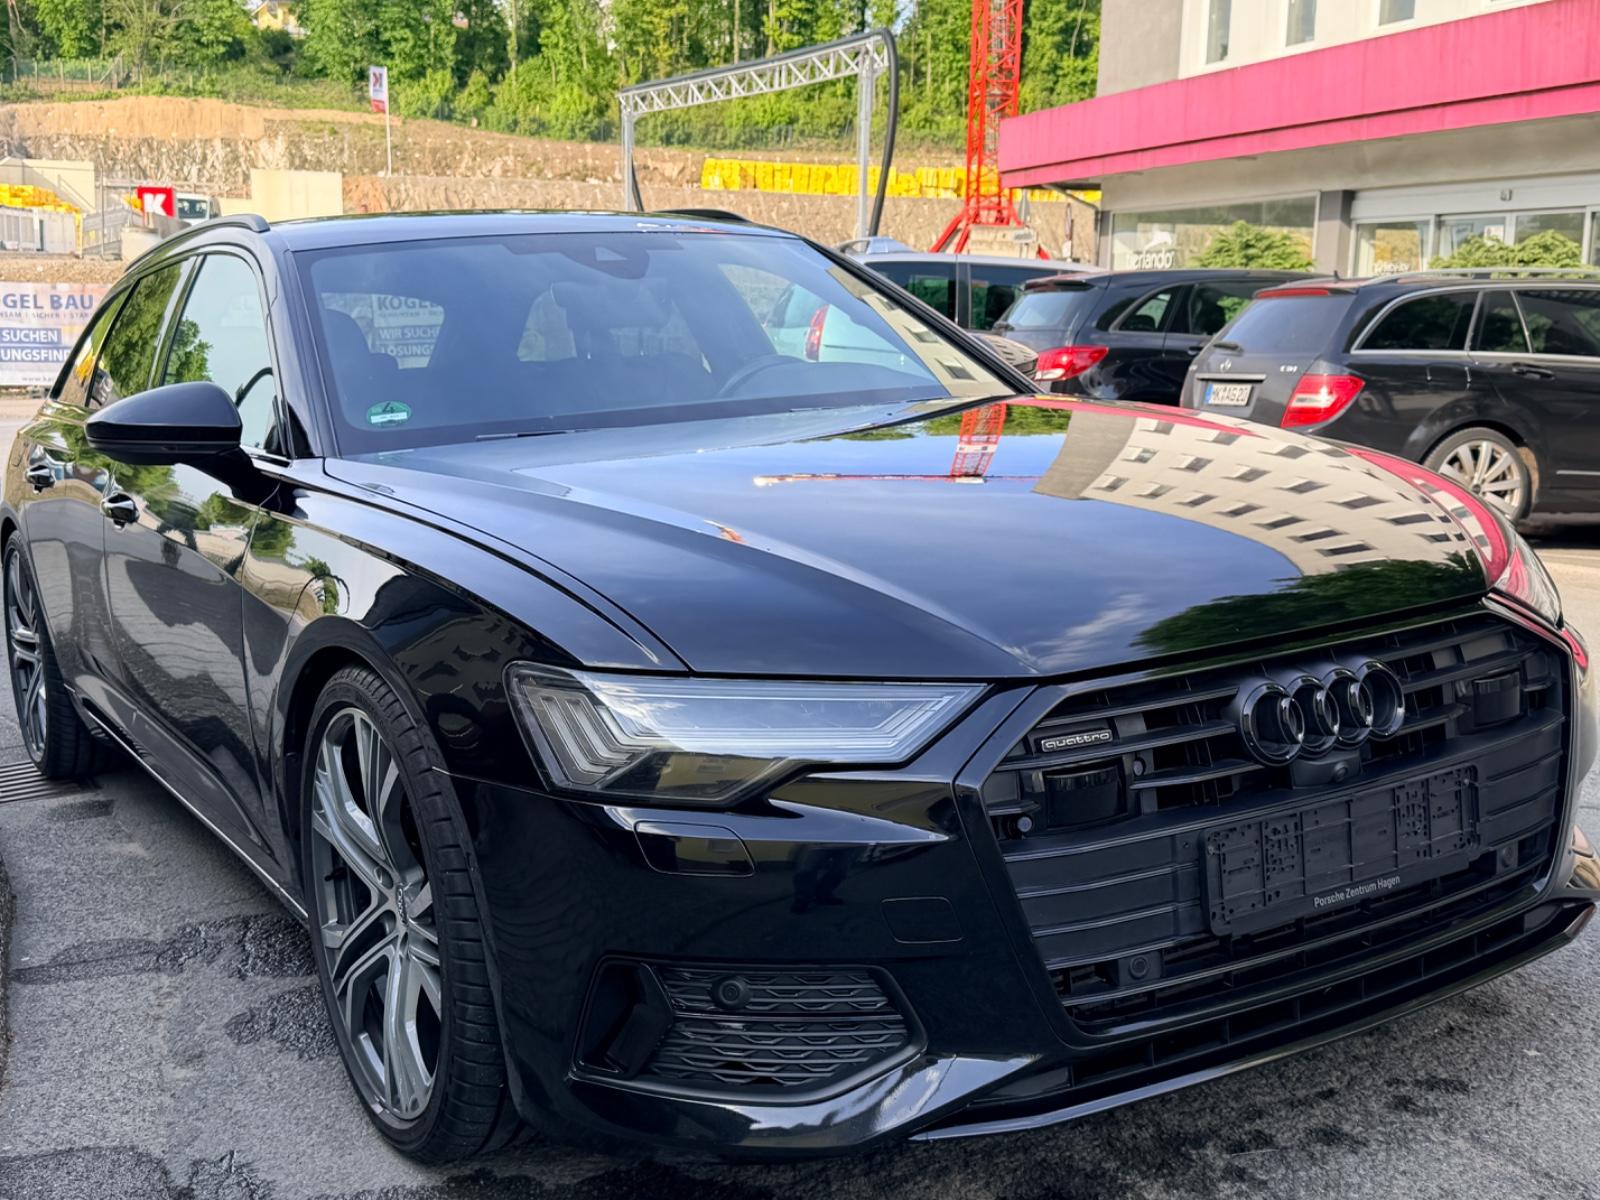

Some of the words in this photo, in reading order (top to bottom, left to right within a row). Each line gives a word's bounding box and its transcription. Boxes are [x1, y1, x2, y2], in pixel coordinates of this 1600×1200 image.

[143, 193, 167, 216] K
[50, 294, 93, 310] BAU
[2, 329, 58, 343] SUCHEN
[1045, 733, 1110, 748] quattro
[1314, 892, 1345, 907] Porsche
[1346, 883, 1377, 897] Zentrum
[1377, 876, 1400, 889] Hagen
